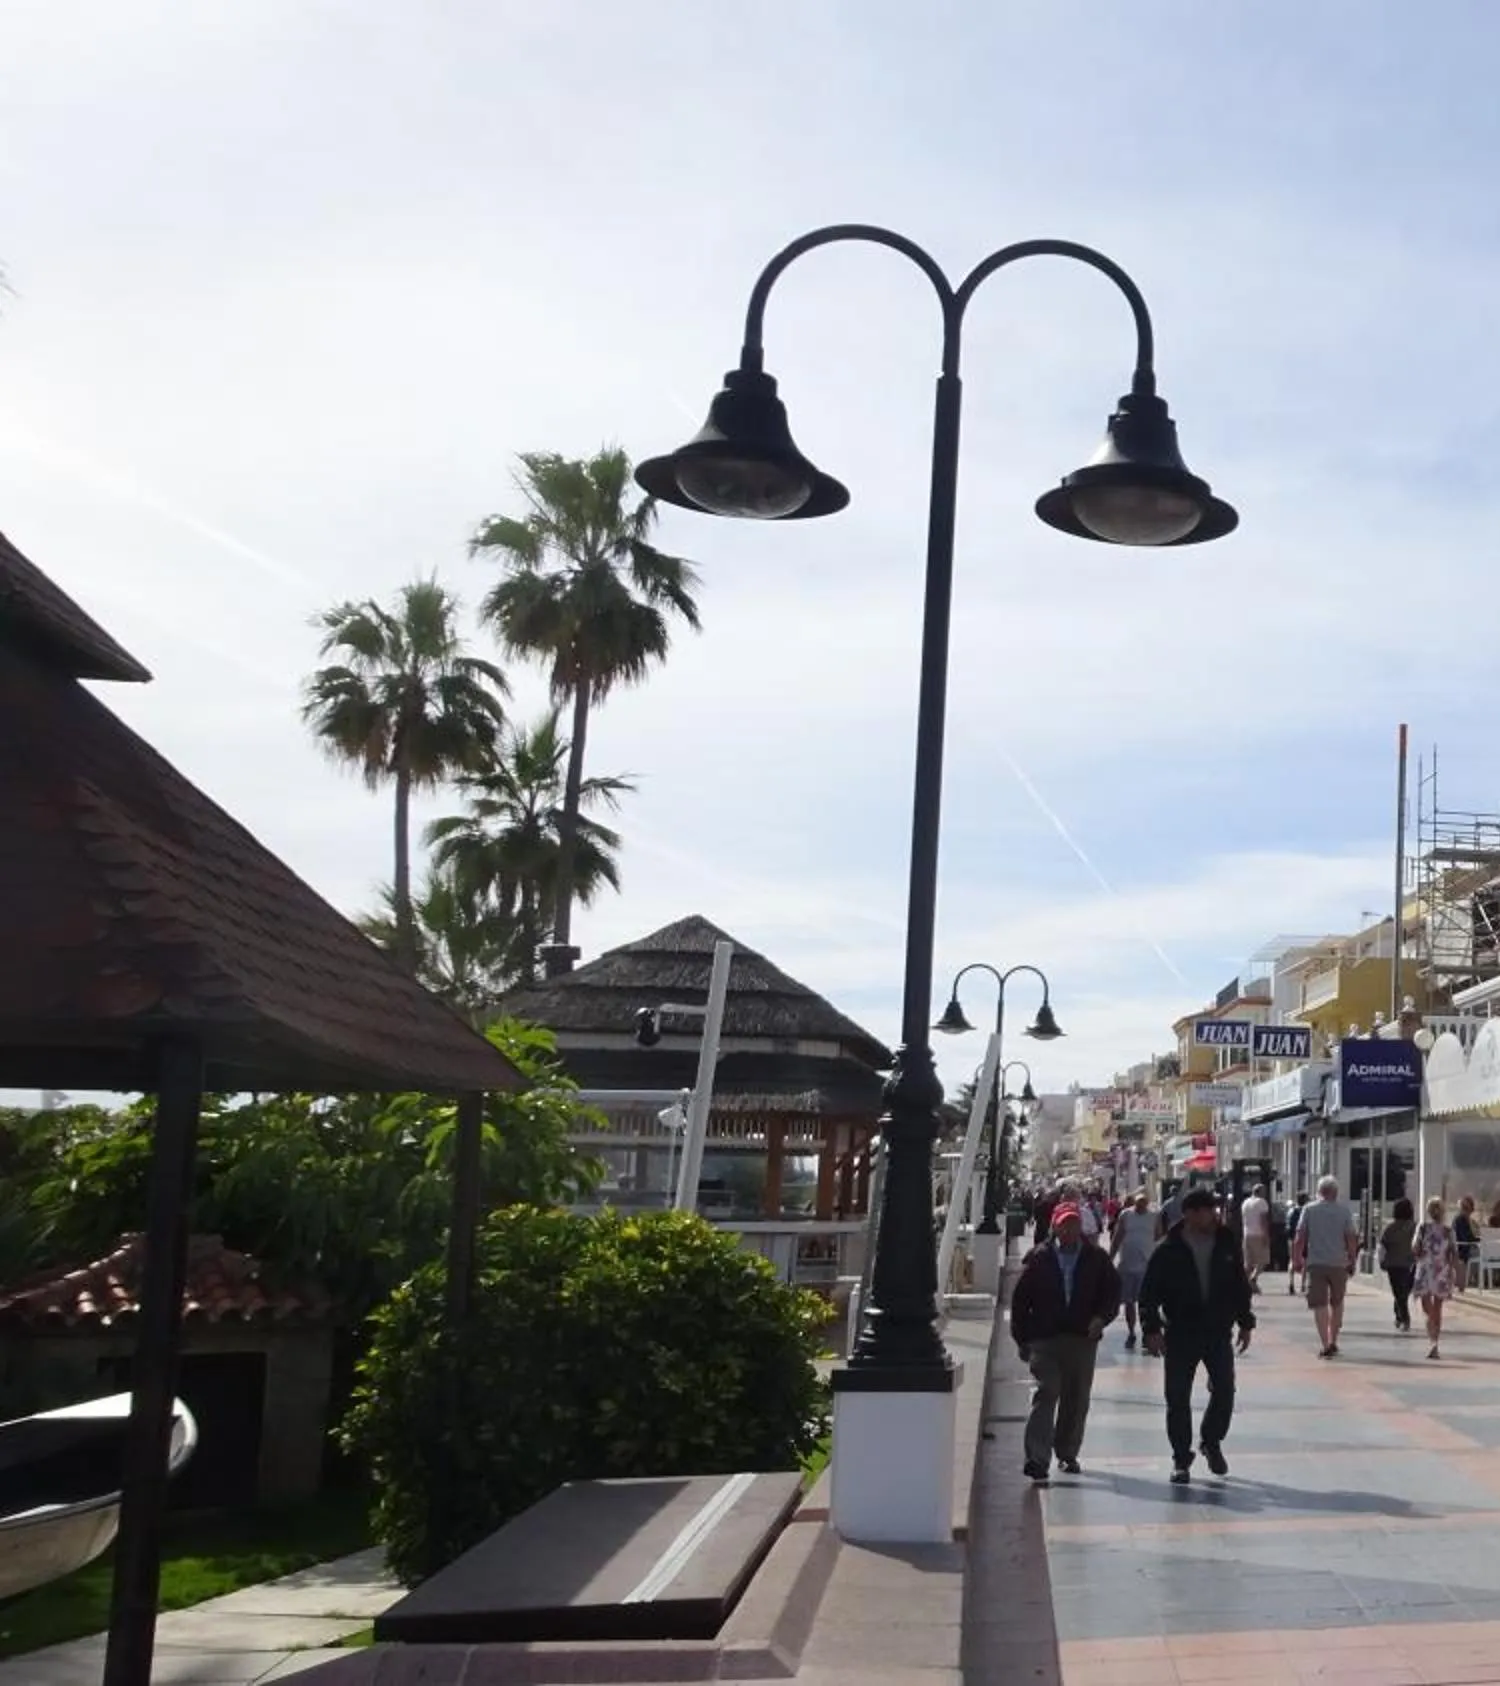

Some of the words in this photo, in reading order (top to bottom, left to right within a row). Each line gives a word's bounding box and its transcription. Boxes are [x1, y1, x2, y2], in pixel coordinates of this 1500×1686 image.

[1197, 1025, 1248, 1042] JUAN
[1255, 1033, 1308, 1055] JUAN
[1347, 1064, 1415, 1077] ADMIRAL
